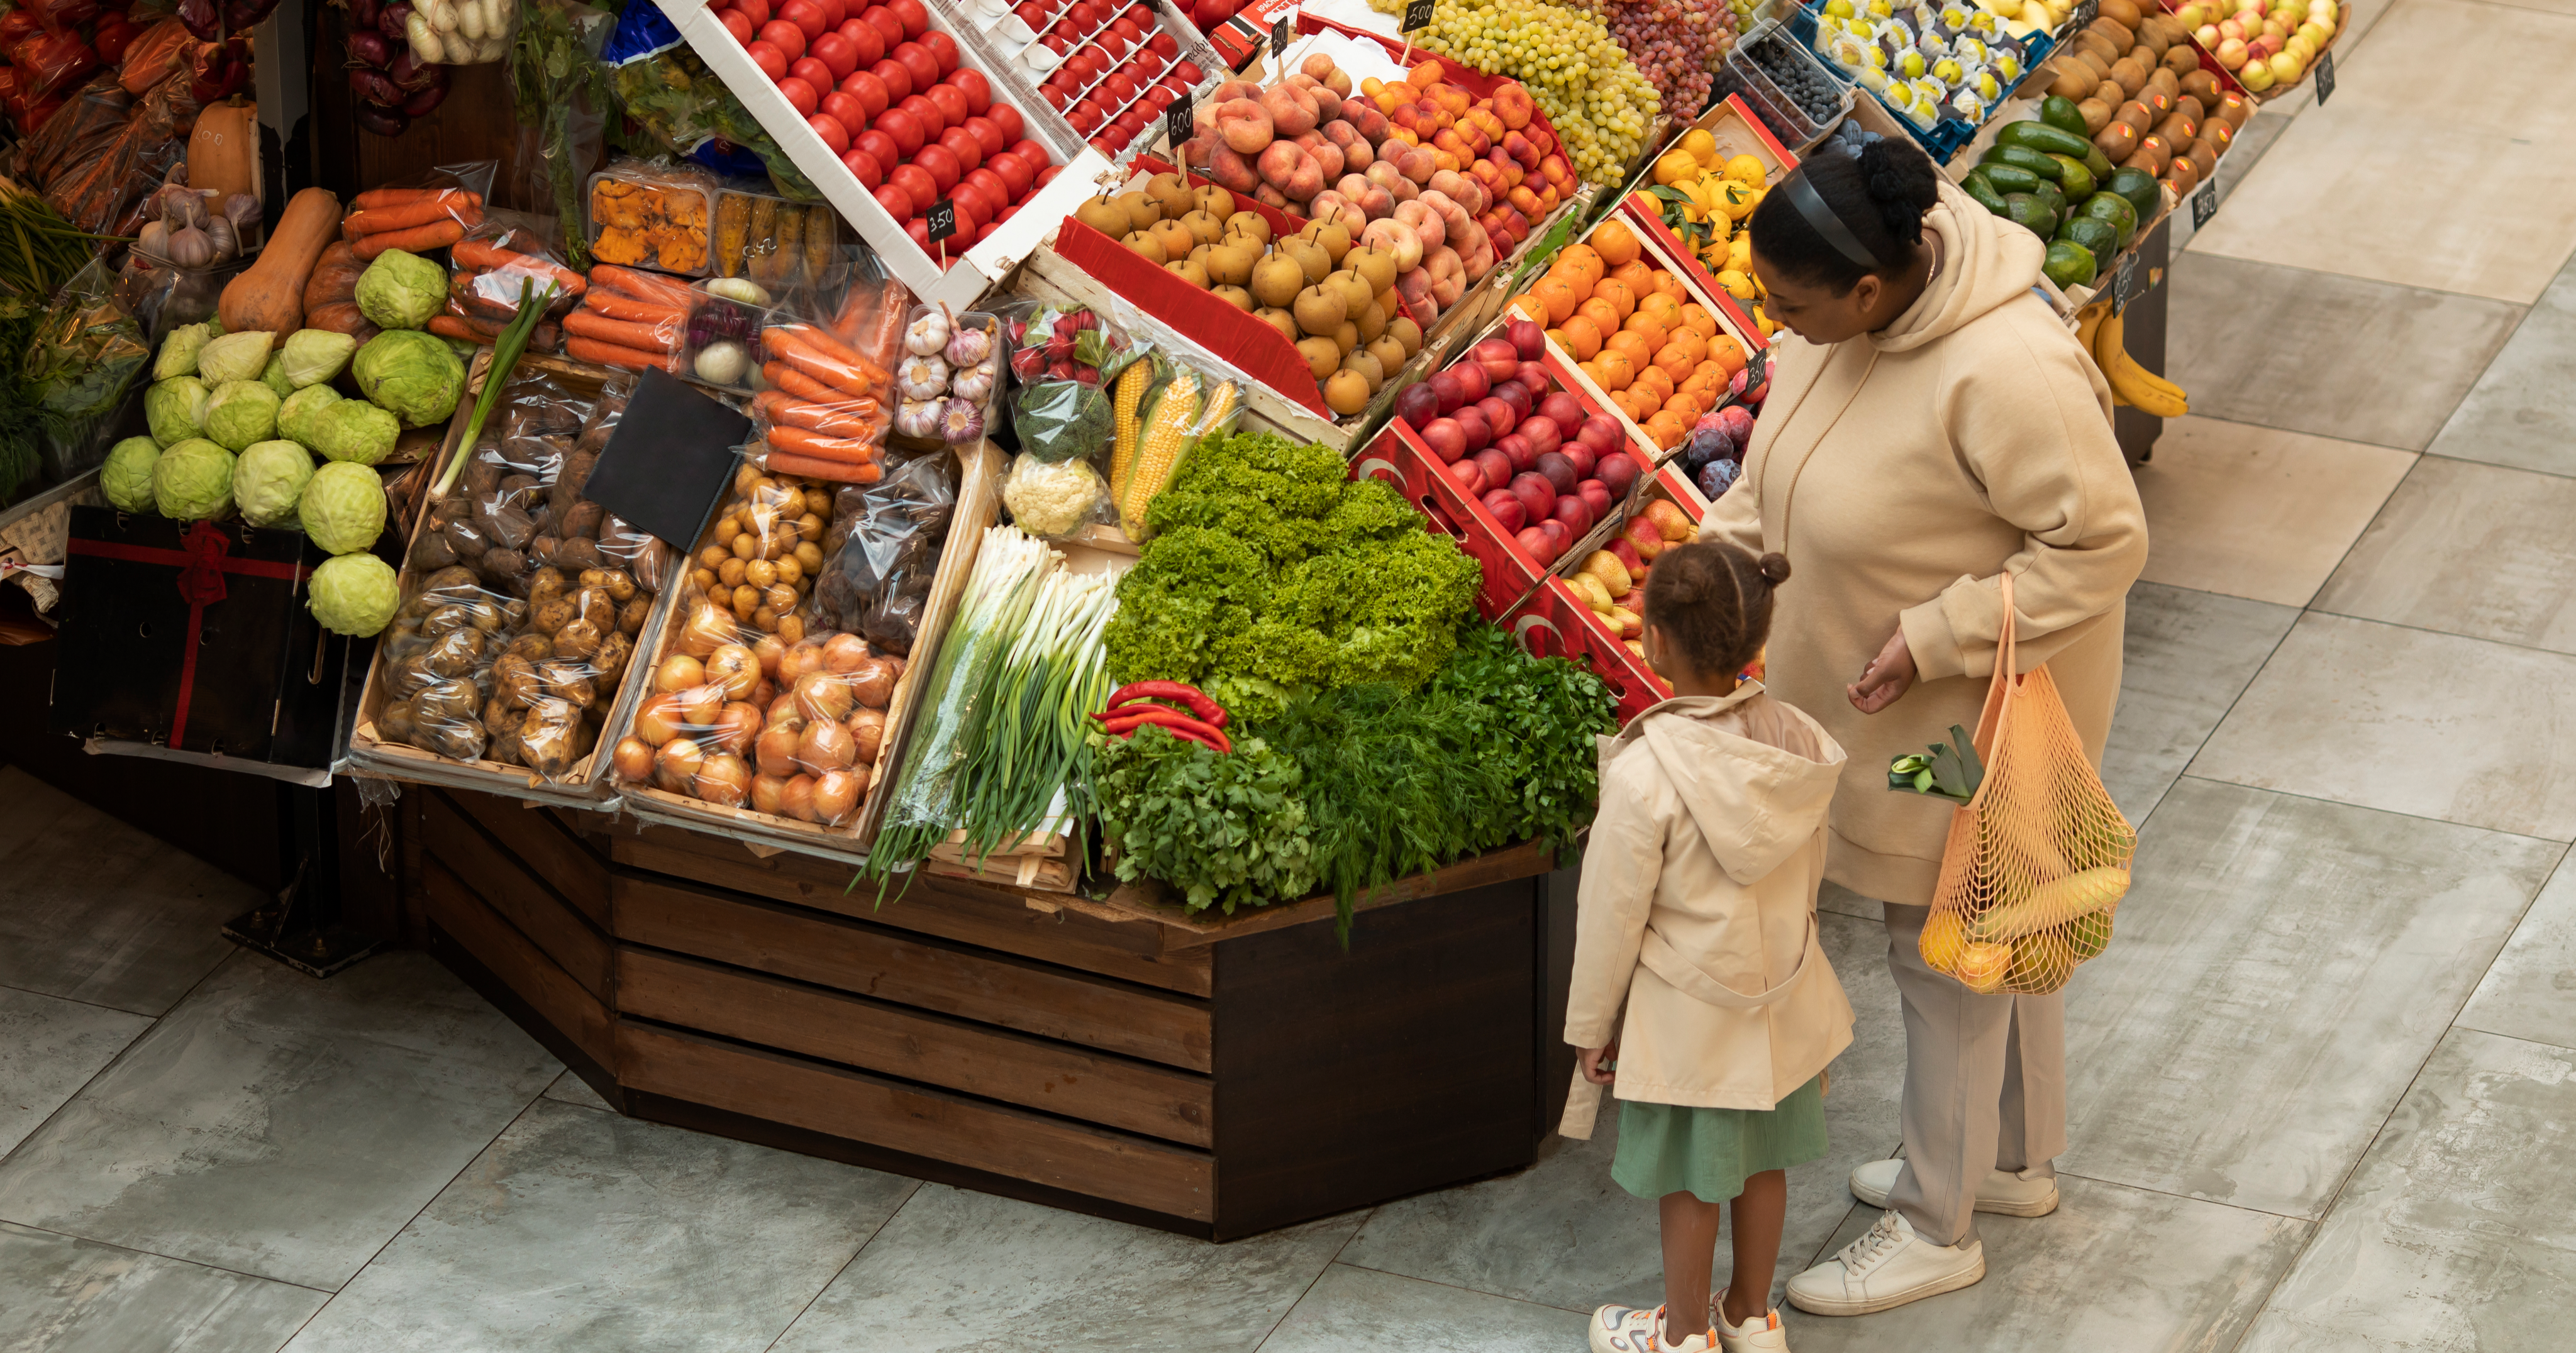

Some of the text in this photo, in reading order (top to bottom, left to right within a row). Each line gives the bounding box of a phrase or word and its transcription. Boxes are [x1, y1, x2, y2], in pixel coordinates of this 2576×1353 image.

[1409, 4, 1432, 25] 500
[1274, 22, 1287, 52] 500
[196, 121, 223, 146] 200
[1172, 108, 1191, 136] 600
[930, 209, 953, 232] 350
[2197, 191, 2217, 223] 350
[1749, 356, 1765, 387] 350
